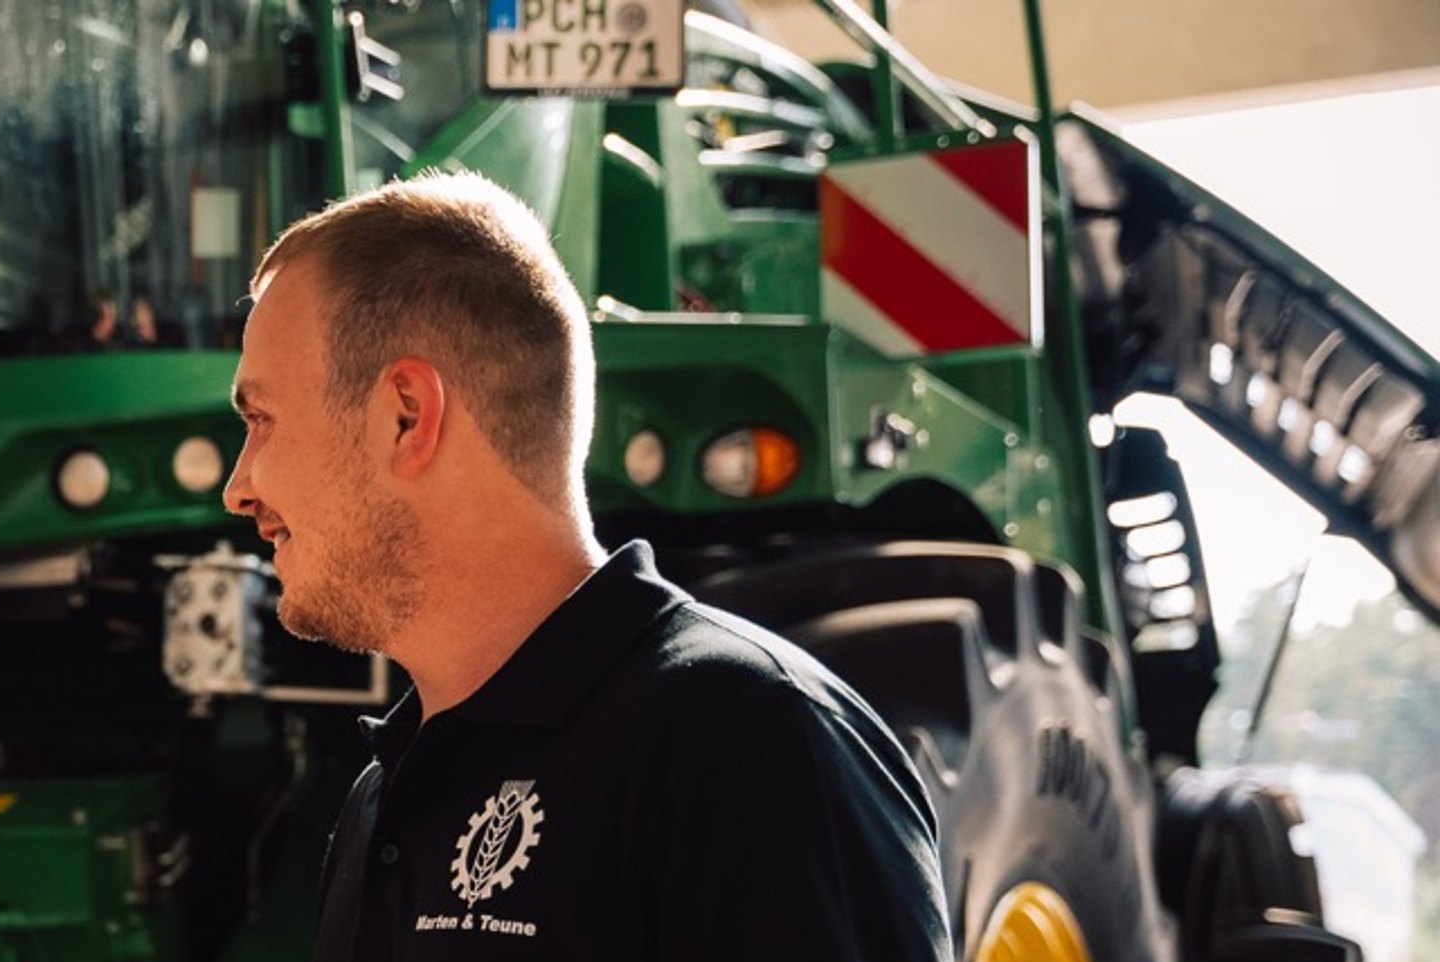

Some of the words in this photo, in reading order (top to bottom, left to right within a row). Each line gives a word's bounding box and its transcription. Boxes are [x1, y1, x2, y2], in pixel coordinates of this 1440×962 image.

[523, 0, 607, 33] PCH
[506, 42, 561, 78] MT
[579, 40, 660, 79] 971
[461, 912, 474, 930] &
[480, 914, 537, 936] Teune
